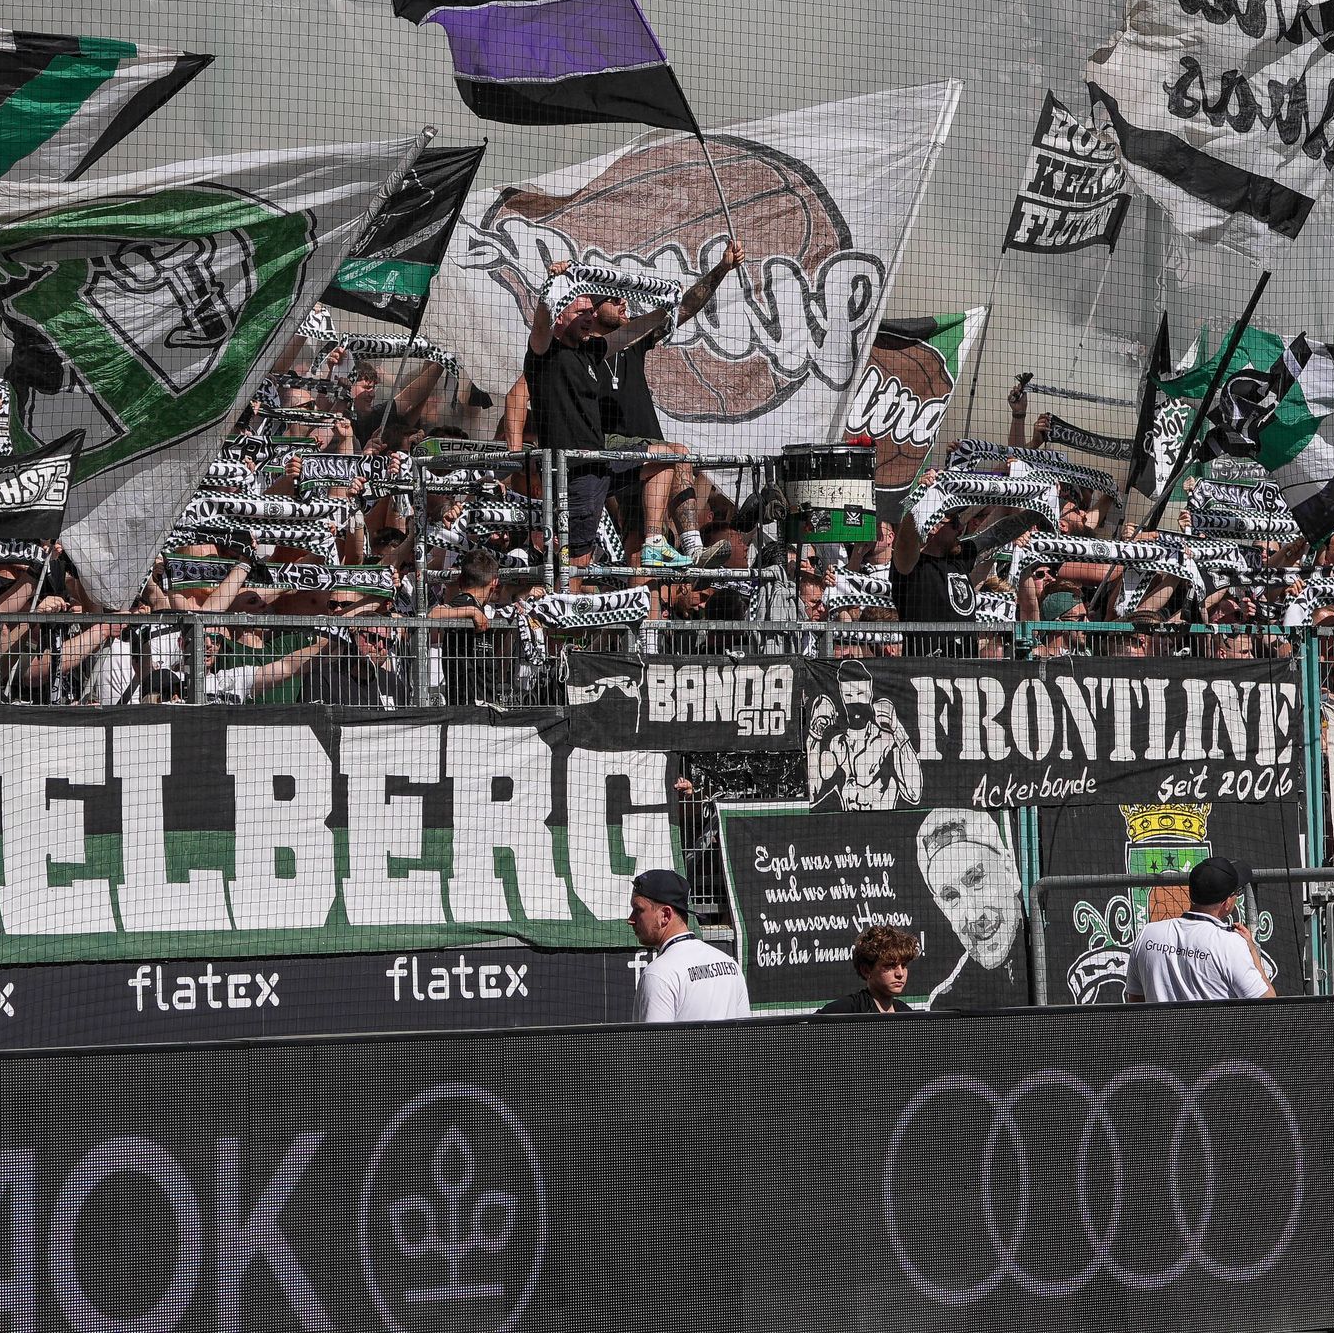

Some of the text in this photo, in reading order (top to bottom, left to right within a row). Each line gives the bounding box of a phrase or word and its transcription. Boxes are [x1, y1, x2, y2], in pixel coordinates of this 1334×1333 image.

[647, 664, 792, 722] BANDA
[910, 674, 1299, 764] FRONTLINE
[754, 844, 798, 878] Egal
[1144, 937, 1212, 964] Gruppenleiter
[127, 963, 279, 1011] flatex
[385, 952, 529, 1002] flatex
